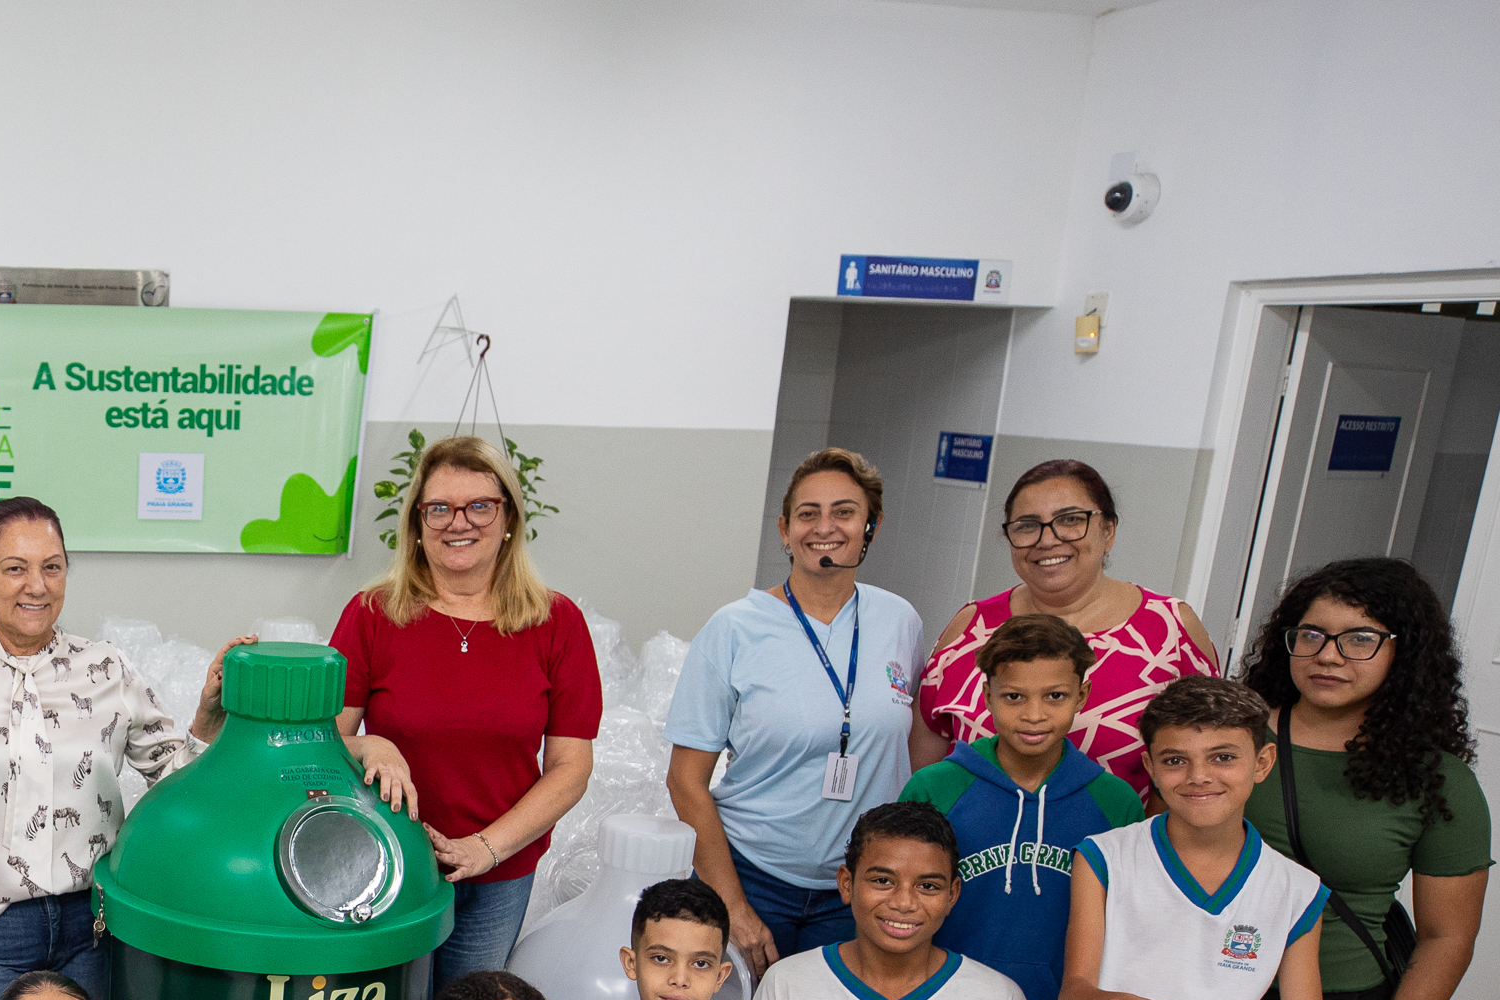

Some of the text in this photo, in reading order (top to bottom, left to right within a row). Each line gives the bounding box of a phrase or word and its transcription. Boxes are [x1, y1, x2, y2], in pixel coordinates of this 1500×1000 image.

[869, 263, 974, 279] SANITÁRIO MASCULINO
[32, 362, 314, 396] A Sustentabilidade
[105, 399, 241, 437] está aqui
